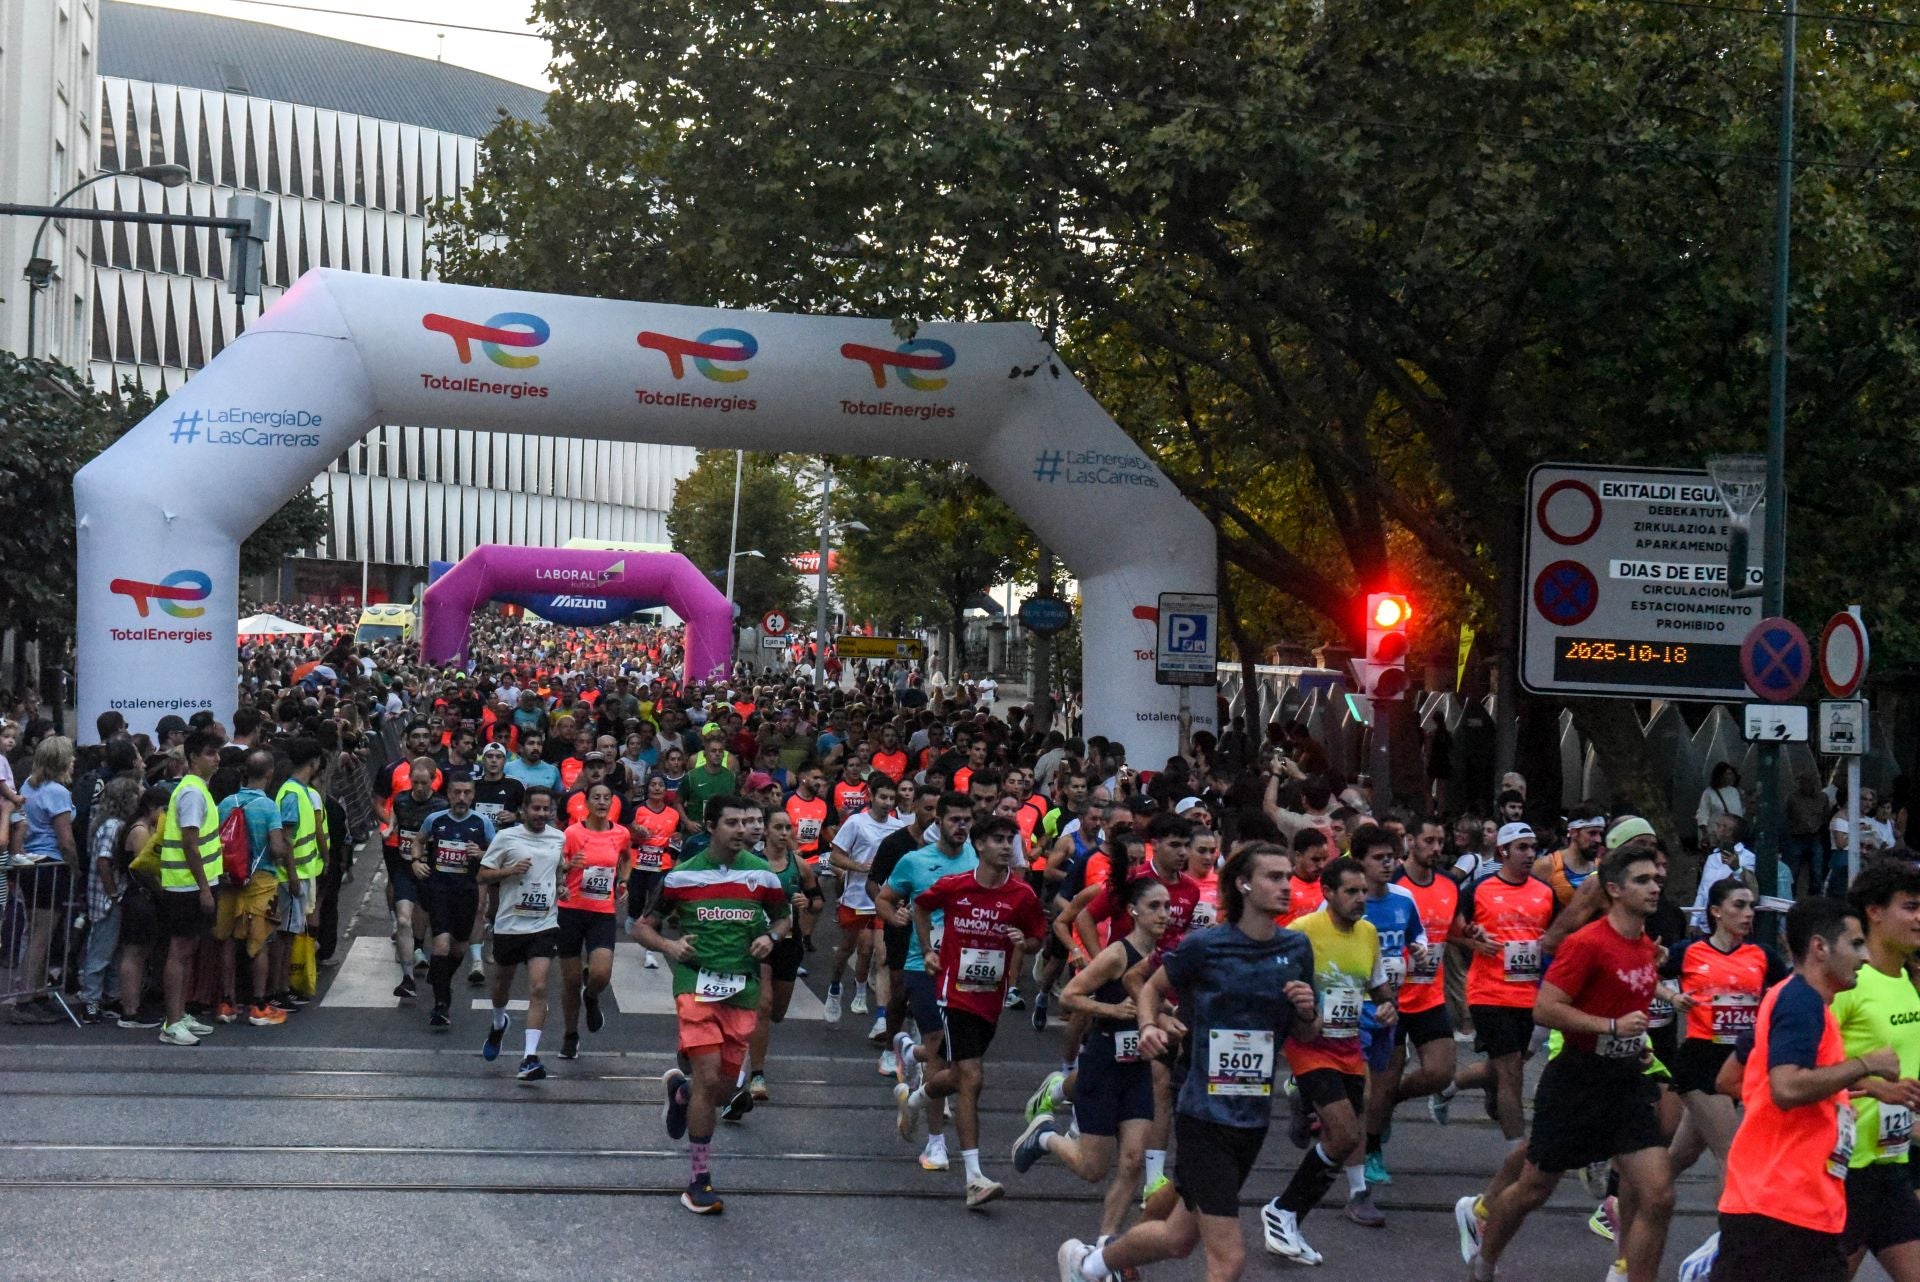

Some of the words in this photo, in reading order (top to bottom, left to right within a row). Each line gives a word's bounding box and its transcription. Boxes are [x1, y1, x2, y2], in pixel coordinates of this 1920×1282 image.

[420, 374, 549, 399] TotalEnergies
[635, 390, 757, 412] TotalEnergies
[840, 400, 955, 420] TotalEnergies
[207, 427, 320, 447] LasCarreras
[1066, 468, 1159, 488] LasCarreras
[1602, 483, 1676, 500] EKITALDI
[1634, 522, 1716, 535] ZIRKULAZIOA
[536, 569, 596, 580] LABORAL
[1620, 563, 1661, 578] DIAS
[1667, 566, 1690, 580] DE
[1695, 567, 1764, 583] EVEO
[1643, 585, 1730, 598] CIRCULACION
[1631, 601, 1752, 616] ESTACIONAMIENTO
[1656, 619, 1725, 631] PROHIBIDO
[110, 628, 213, 644] TotalEnergies
[1565, 642, 1687, 663] 2025-10-18
[110, 697, 212, 710] totalenergies.es
[587, 877, 609, 887] 4932
[522, 893, 547, 903] 7675
[697, 906, 756, 921] Petronor
[971, 908, 1000, 920] CMU
[1168, 906, 1184, 914] MU
[1510, 954, 1536, 964] 4949
[966, 965, 997, 977] 4586
[1715, 1010, 1758, 1024] 21266
[1123, 1037, 1138, 1049] 55
[1219, 1052, 1264, 1070] 5607
